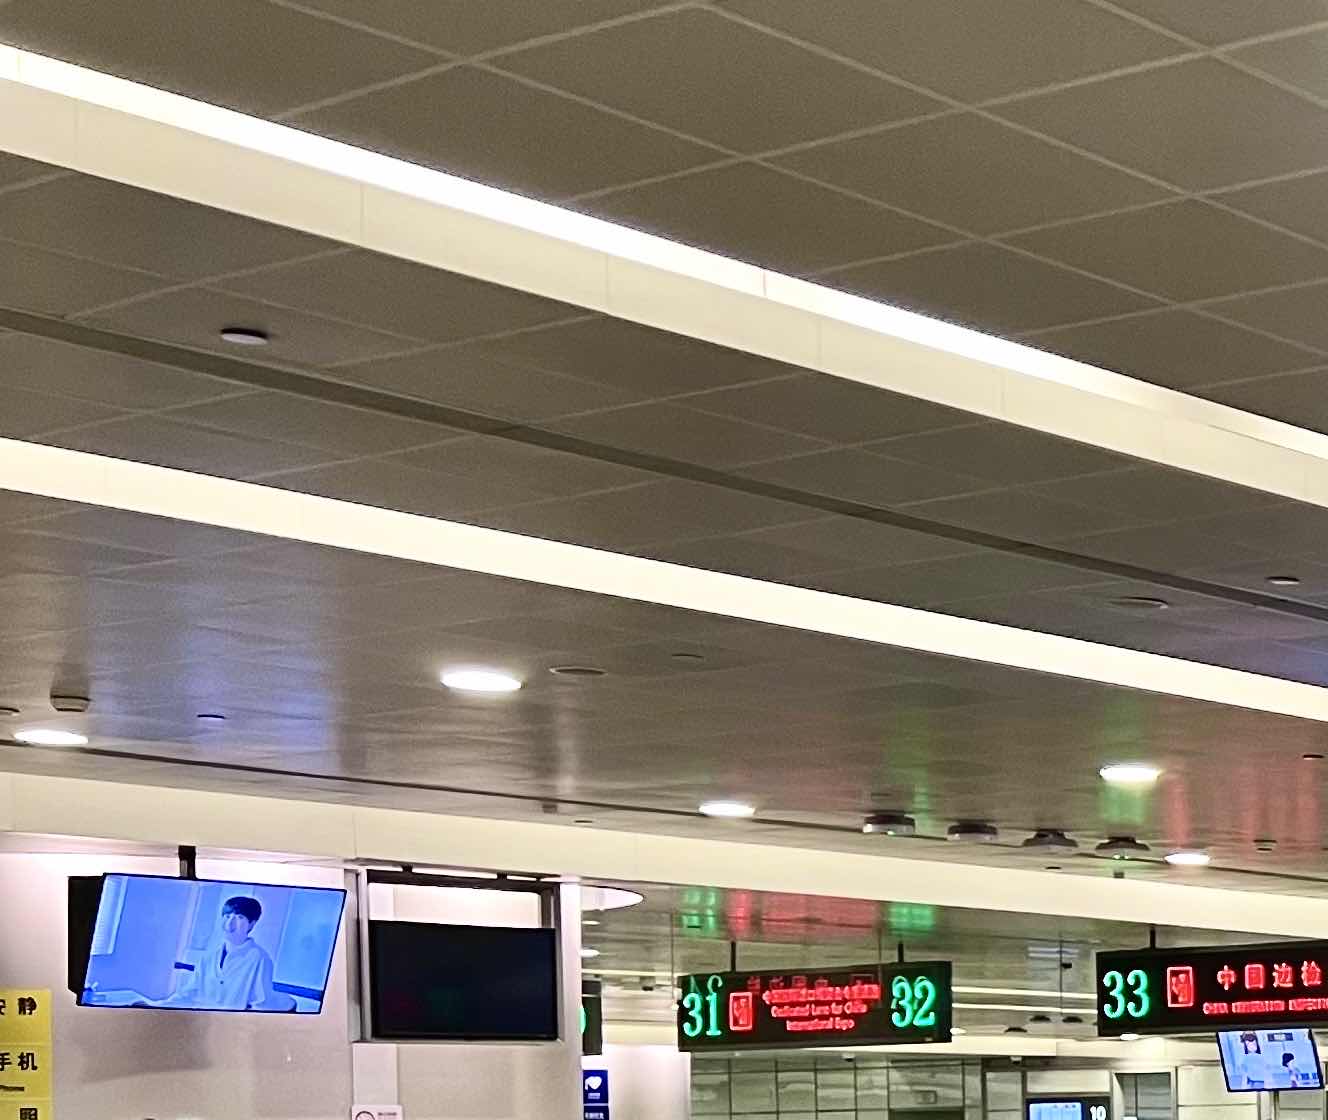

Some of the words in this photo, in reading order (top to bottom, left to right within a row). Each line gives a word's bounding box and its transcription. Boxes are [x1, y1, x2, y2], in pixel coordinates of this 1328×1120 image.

[1104, 970, 1149, 1018] 33
[1217, 961, 1321, 989] 中国边检
[683, 990, 721, 1037] 31
[892, 979, 936, 1027] 32
